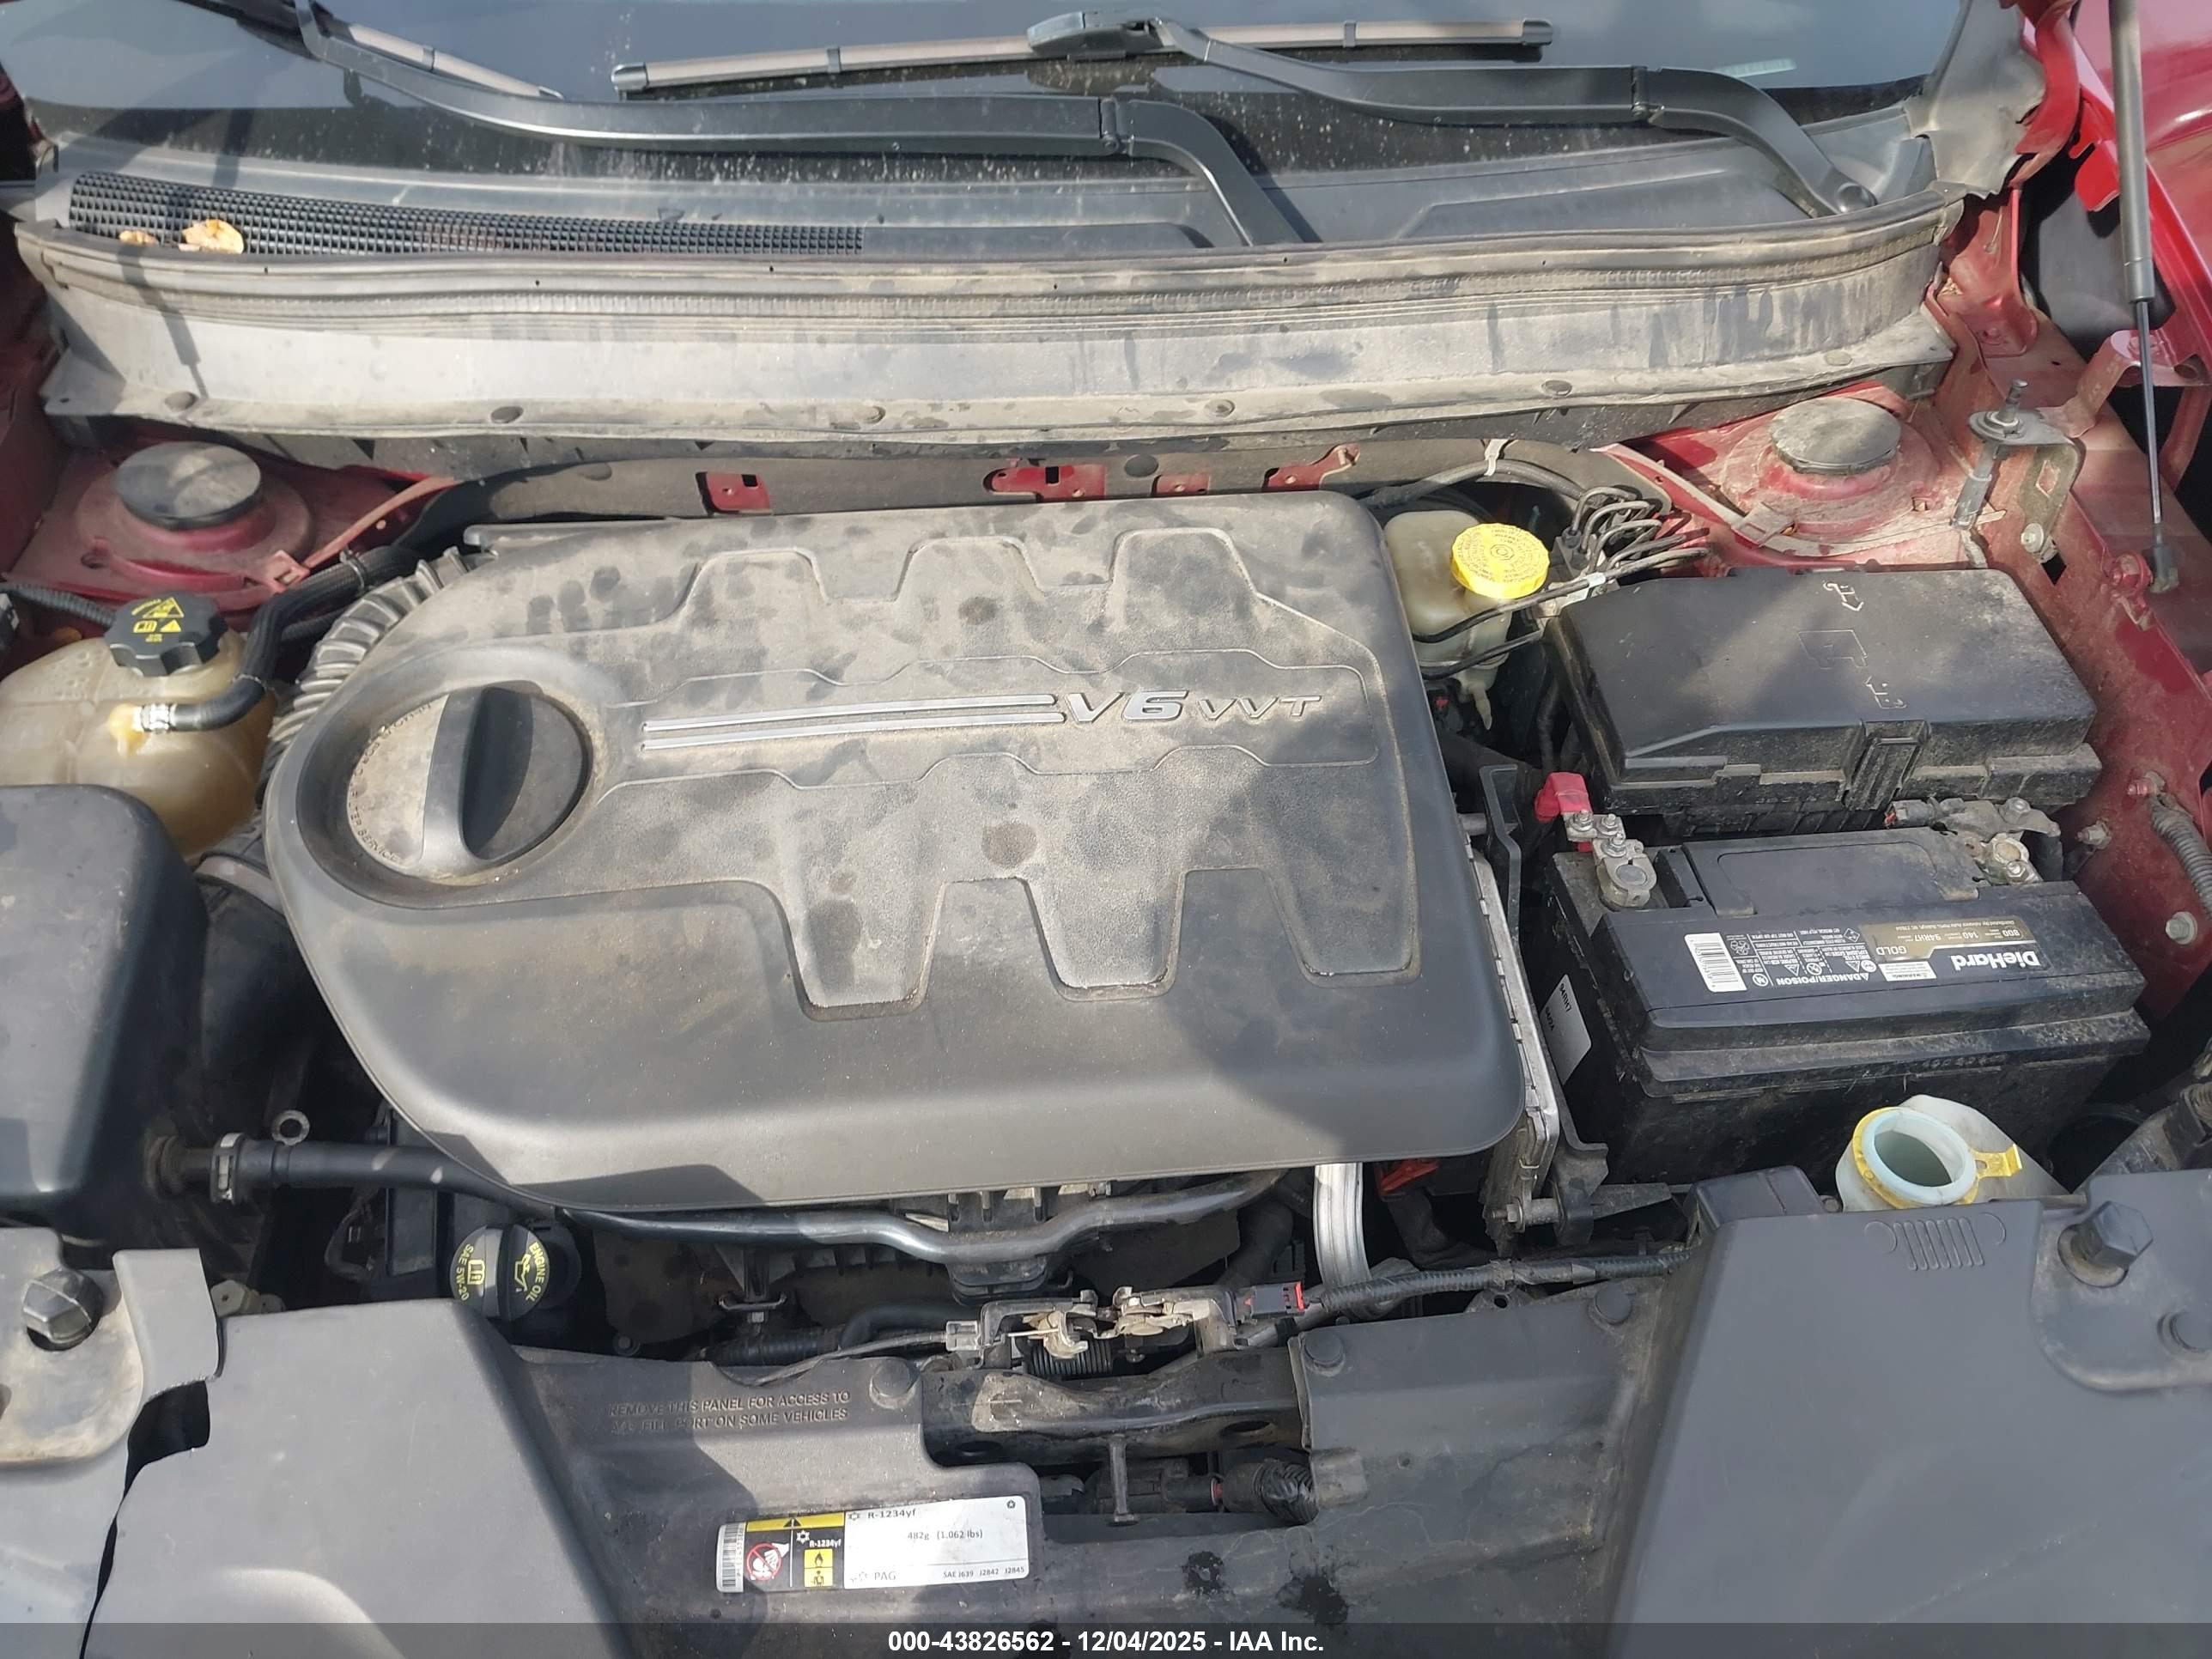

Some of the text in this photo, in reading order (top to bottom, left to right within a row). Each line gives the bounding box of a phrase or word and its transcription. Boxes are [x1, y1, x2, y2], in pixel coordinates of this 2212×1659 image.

[1066, 690, 1323, 724] V6 VVT
[1913, 933, 1942, 941] 94RH7
[1961, 931, 1979, 939] 140
[2002, 928, 2021, 937] 800
[1875, 945, 1907, 956] GOLD
[1950, 951, 2041, 971] DieHard
[456, 1243, 474, 1302] SAE 5W-20
[525, 1242, 547, 1304] ENGINE OIL
[609, 1402, 664, 1416] REMOVE
[702, 1397, 744, 1412] PANEL
[748, 1395, 775, 1409] FOR
[778, 1393, 830, 1407] ACCESS
[832, 1390, 850, 1405] TO
[714, 1414, 736, 1428] ON
[739, 1412, 779, 1427] SOME
[783, 1407, 848, 1424] VEHICLES
[866, 1507, 917, 1520] R-1234yf
[907, 1528, 983, 1541] 482g (1.062 lbs)
[874, 1571, 896, 1581] PAG
